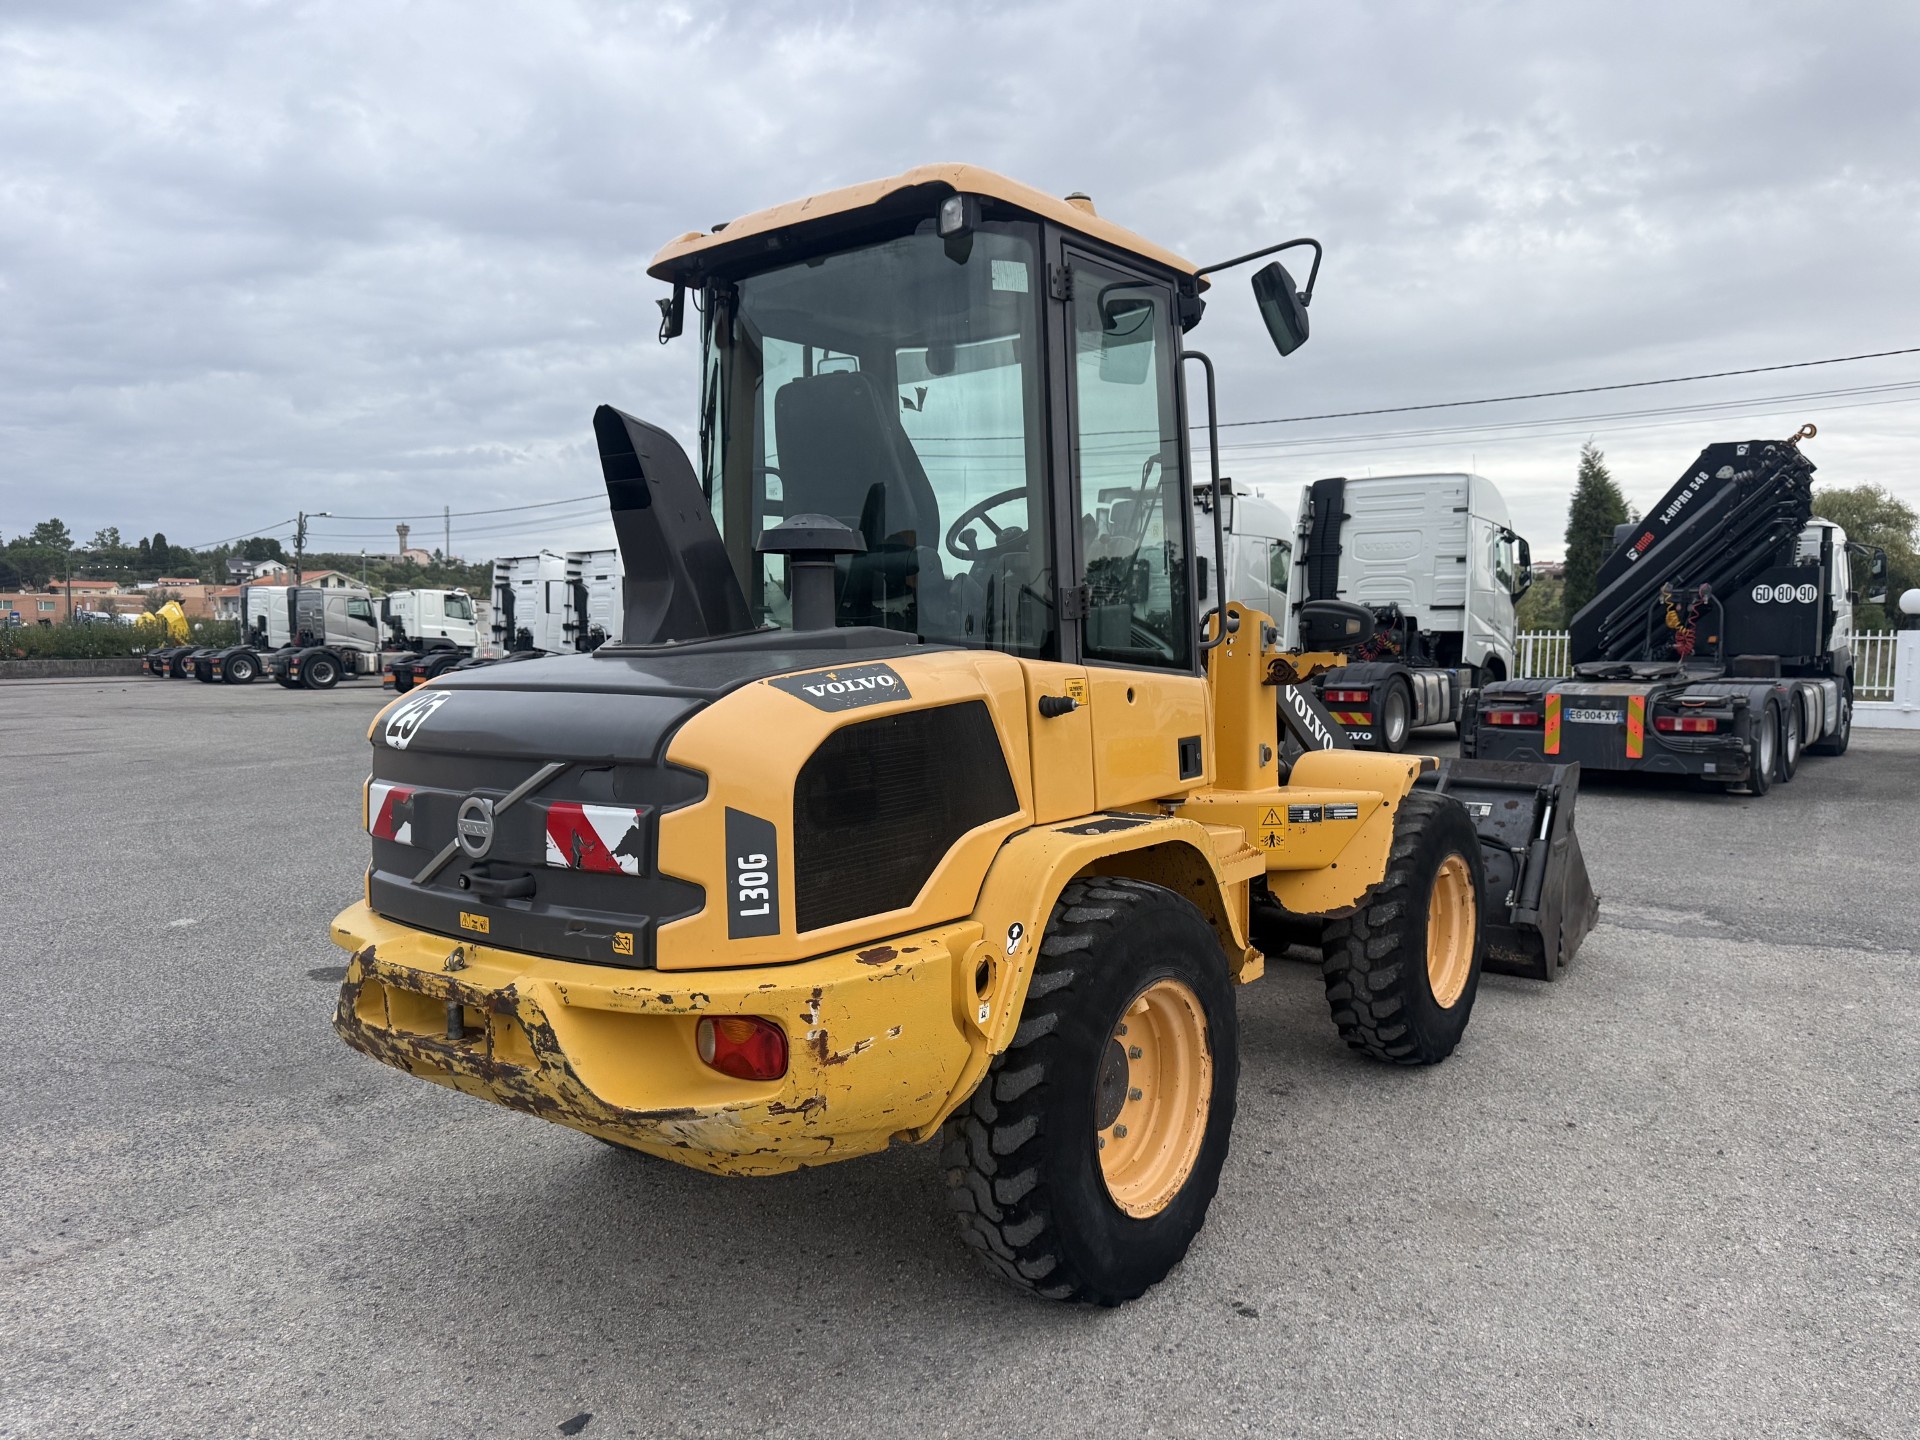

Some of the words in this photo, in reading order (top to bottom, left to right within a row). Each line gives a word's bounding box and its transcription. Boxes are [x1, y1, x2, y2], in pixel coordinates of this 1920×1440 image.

[1659, 489, 1693, 525] X-HIPRO
[1689, 470, 1710, 492] 548
[1634, 531, 1655, 552] HIAB
[1755, 586, 1770, 601] 60
[1777, 586, 1793, 601] 80
[1799, 586, 1815, 601] 90
[802, 674, 895, 697] VOLVO
[386, 692, 450, 740] 25
[1285, 684, 1334, 751] VOLVO
[458, 822, 489, 836] VOLVO
[737, 853, 770, 917] L30G
